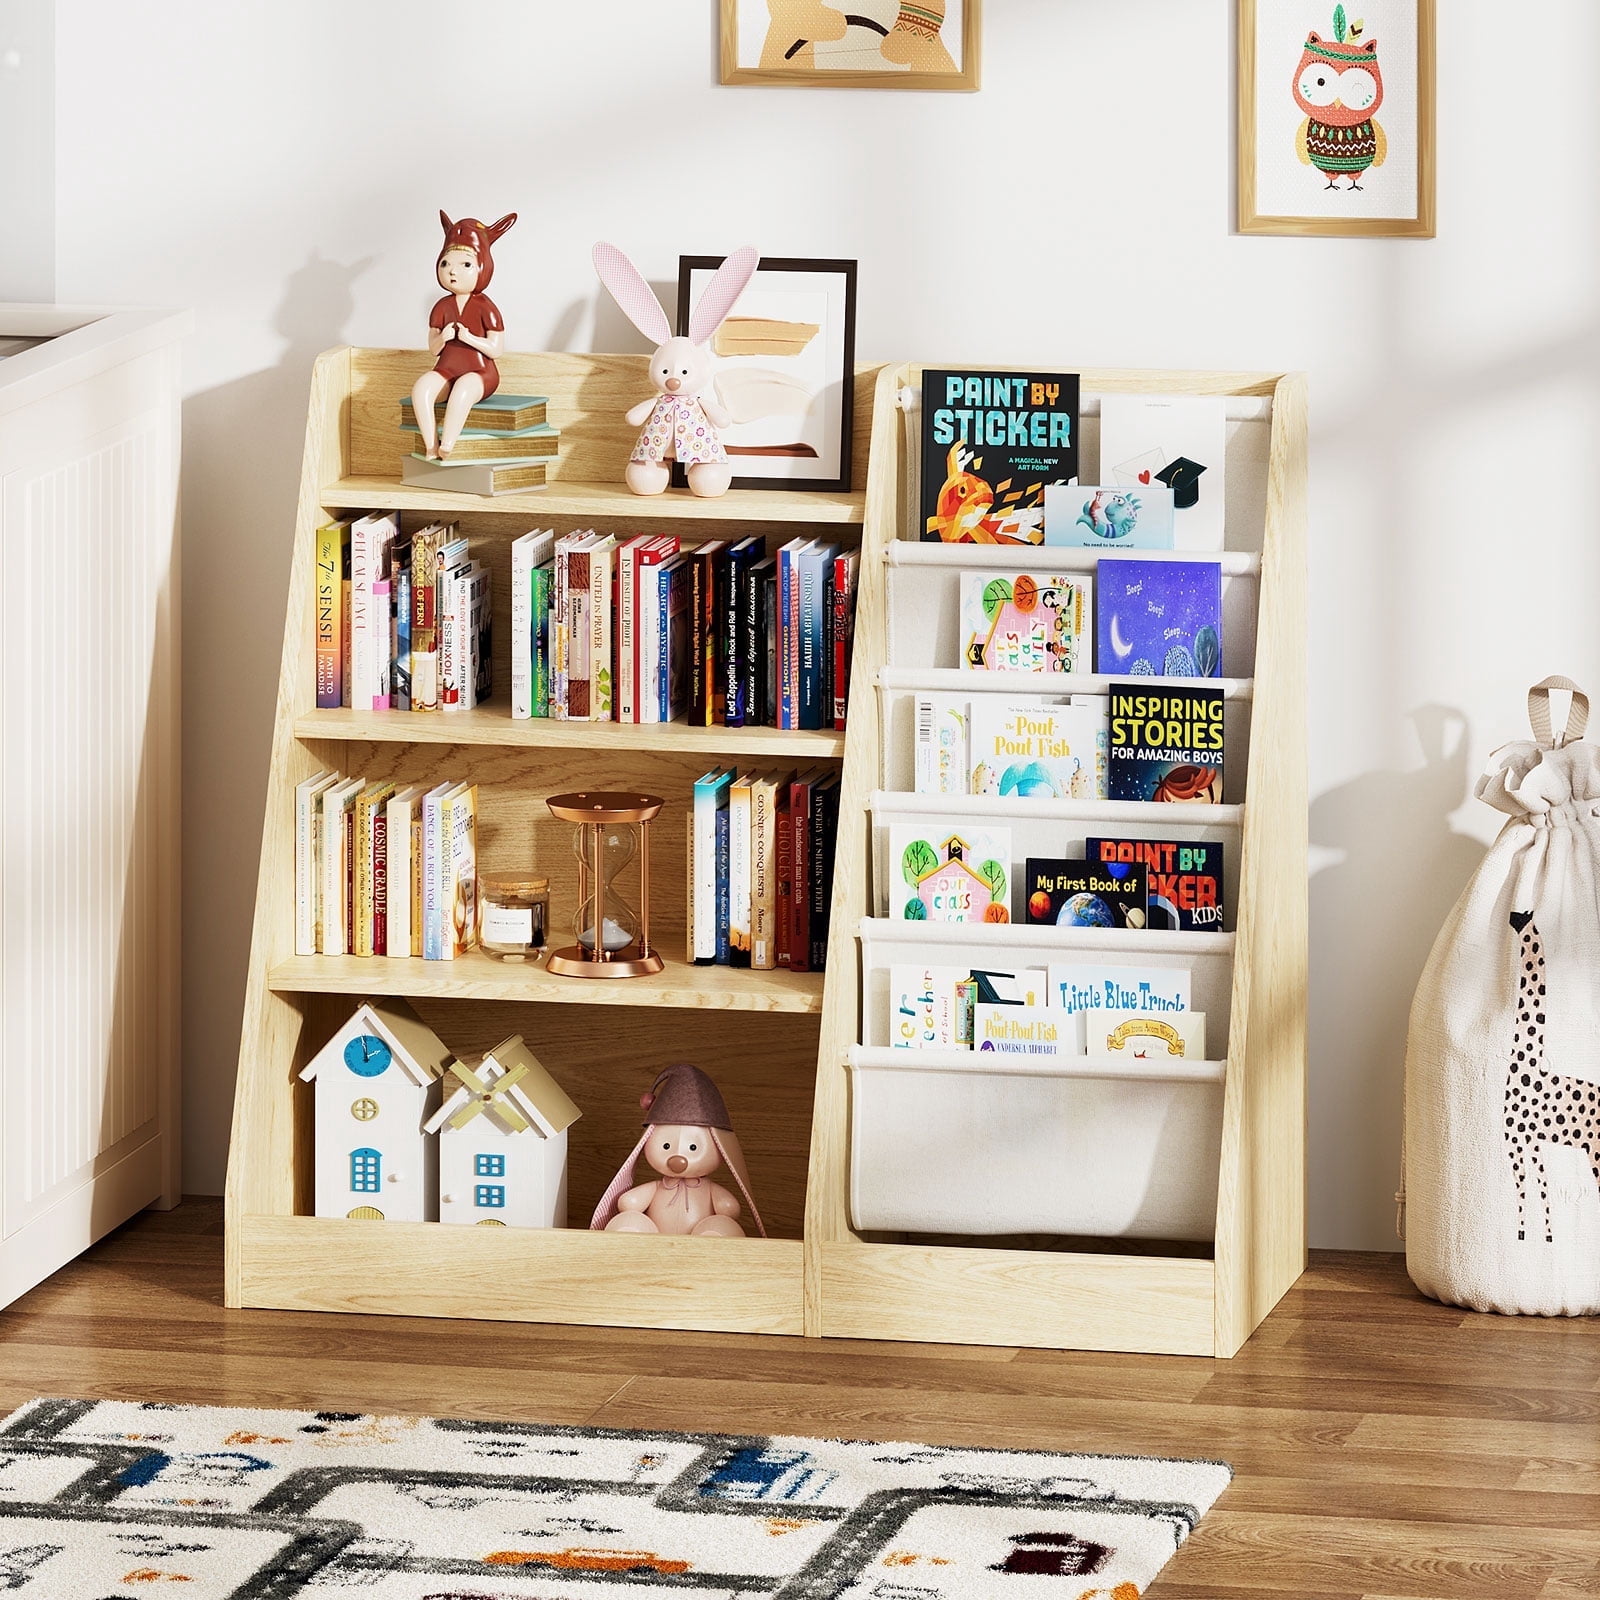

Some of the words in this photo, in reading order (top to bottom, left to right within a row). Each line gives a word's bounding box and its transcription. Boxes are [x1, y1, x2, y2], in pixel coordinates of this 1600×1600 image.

[946, 376, 1028, 407] PAINT
[1031, 383, 1060, 406] BY
[933, 409, 1071, 448] STICKER
[594, 566, 603, 603] UNITED
[319, 585, 332, 643] SENSE
[416, 602, 425, 626] PERN
[728, 610, 736, 624] Roll
[804, 571, 814, 635] АВИАНОСЦЫ
[594, 615, 603, 649] PRAYER
[622, 620, 631, 648] PROFIT
[728, 624, 736, 638] and
[1031, 619, 1045, 673] AMILY
[728, 639, 736, 655] Rock
[804, 637, 812, 669] НАШИ
[318, 655, 326, 696] PARADISE
[326, 657, 334, 679] PATH
[727, 664, 738, 700] Zeppelin
[326, 681, 334, 695] TO
[746, 675, 755, 716] Записки
[727, 700, 736, 716] Led
[1112, 695, 1223, 721] INSPIRING
[993, 736, 1033, 756] Pout
[1037, 737, 1070, 758] Fish
[1112, 718, 1223, 749] STORIES
[1112, 747, 1135, 760] FOR
[1136, 748, 1191, 763] AMAZING
[1192, 751, 1223, 764] BOYS
[427, 804, 435, 836] DANCE
[757, 794, 765, 839] CONNIE'S
[374, 822, 387, 866] COSMIC
[427, 838, 435, 850] OF
[778, 820, 791, 878] CHOICES
[427, 863, 435, 885] RICH
[757, 840, 765, 898] CONQUESTS
[795, 866, 803, 880] man
[1179, 848, 1207, 872] BY
[374, 869, 387, 914] CRADLE
[427, 887, 435, 911] YOGI
[1037, 875, 1054, 892] My
[1056, 876, 1087, 891] First
[1089, 877, 1120, 892] Book
[1123, 879, 1138, 893] of
[1148, 874, 1217, 910] CKER
[757, 908, 766, 934] Moore
[1190, 904, 1223, 925] KIDS
[917, 970, 935, 1043] eacher
[1059, 982, 1101, 1014] Little
[1104, 980, 1138, 1010] Blue
[1037, 1022, 1058, 1042] Fish
